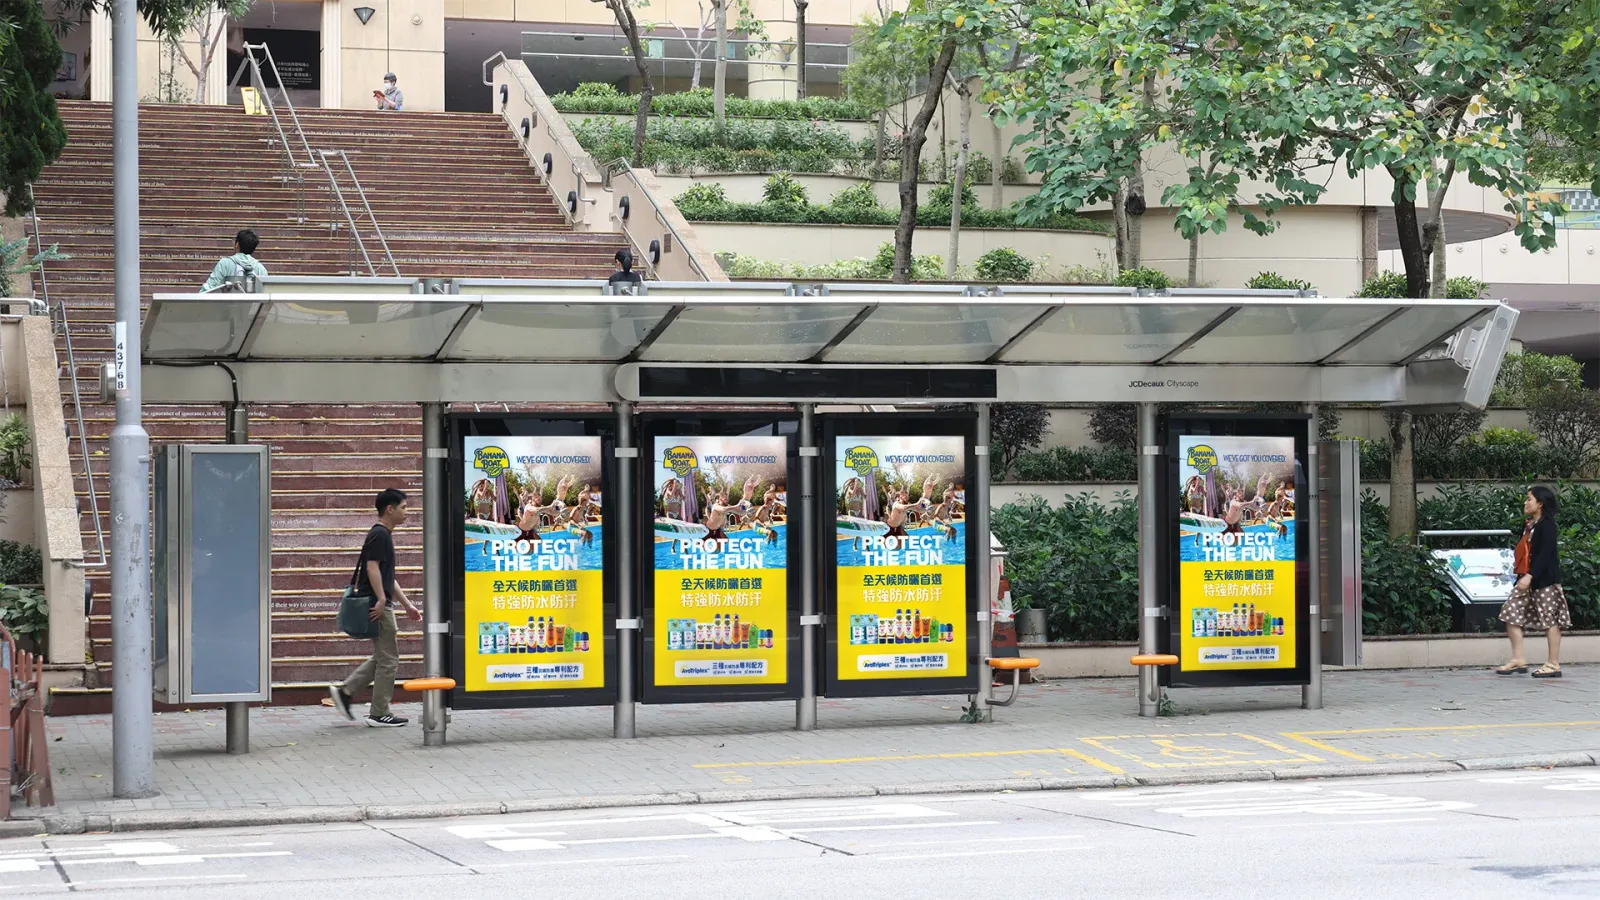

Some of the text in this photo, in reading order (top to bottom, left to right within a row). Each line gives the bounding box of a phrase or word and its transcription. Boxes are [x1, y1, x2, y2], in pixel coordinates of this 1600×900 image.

[1166, 380, 1199, 388] Cityscape
[477, 449, 506, 460] BANANA
[666, 449, 695, 460] BANANA
[848, 449, 876, 459] BANANA
[885, 455, 902, 463] WE'VE
[903, 455, 914, 463] GOT
[915, 455, 927, 463] YOU
[1190, 448, 1214, 458] BANANA
[1223, 454, 1239, 463] WE'VE
[1239, 454, 1250, 463] GOT
[1251, 454, 1261, 463] YOU
[481, 459, 502, 469] BOAT
[516, 456, 535, 464] WE'VE
[535, 456, 548, 464] GOT
[549, 456, 562, 464] YOU
[670, 459, 690, 469] BOAT
[704, 456, 722, 464] WE'VE
[723, 456, 735, 464] GOT
[736, 456, 748, 464] YOU
[852, 459, 871, 469] BOAT
[1194, 457, 1211, 467] BOAT
[862, 536, 943, 550] PROTECT
[1202, 532, 1275, 546] PROTECT
[492, 540, 575, 554] PROTECT
[680, 538, 764, 553] PROTECT
[861, 550, 942, 566] THE FUN
[1202, 547, 1275, 561] THE FUN
[491, 555, 578, 571] THE FUN
[680, 554, 763, 569] THE FUN
[863, 574, 942, 586] 全天候防曬首選
[1204, 569, 1274, 581] 全天候防曬首選
[493, 579, 577, 593] 全天候防曬首選
[681, 578, 762, 590] 全天候防曬首選
[1203, 582, 1274, 597] 特強防水防汗
[681, 592, 762, 608] 特強防水防汗
[863, 588, 942, 603] 特強防水防汗
[288, 602, 299, 610] way
[307, 601, 337, 610] opportunity
[492, 594, 577, 610] 特強防水防汗
